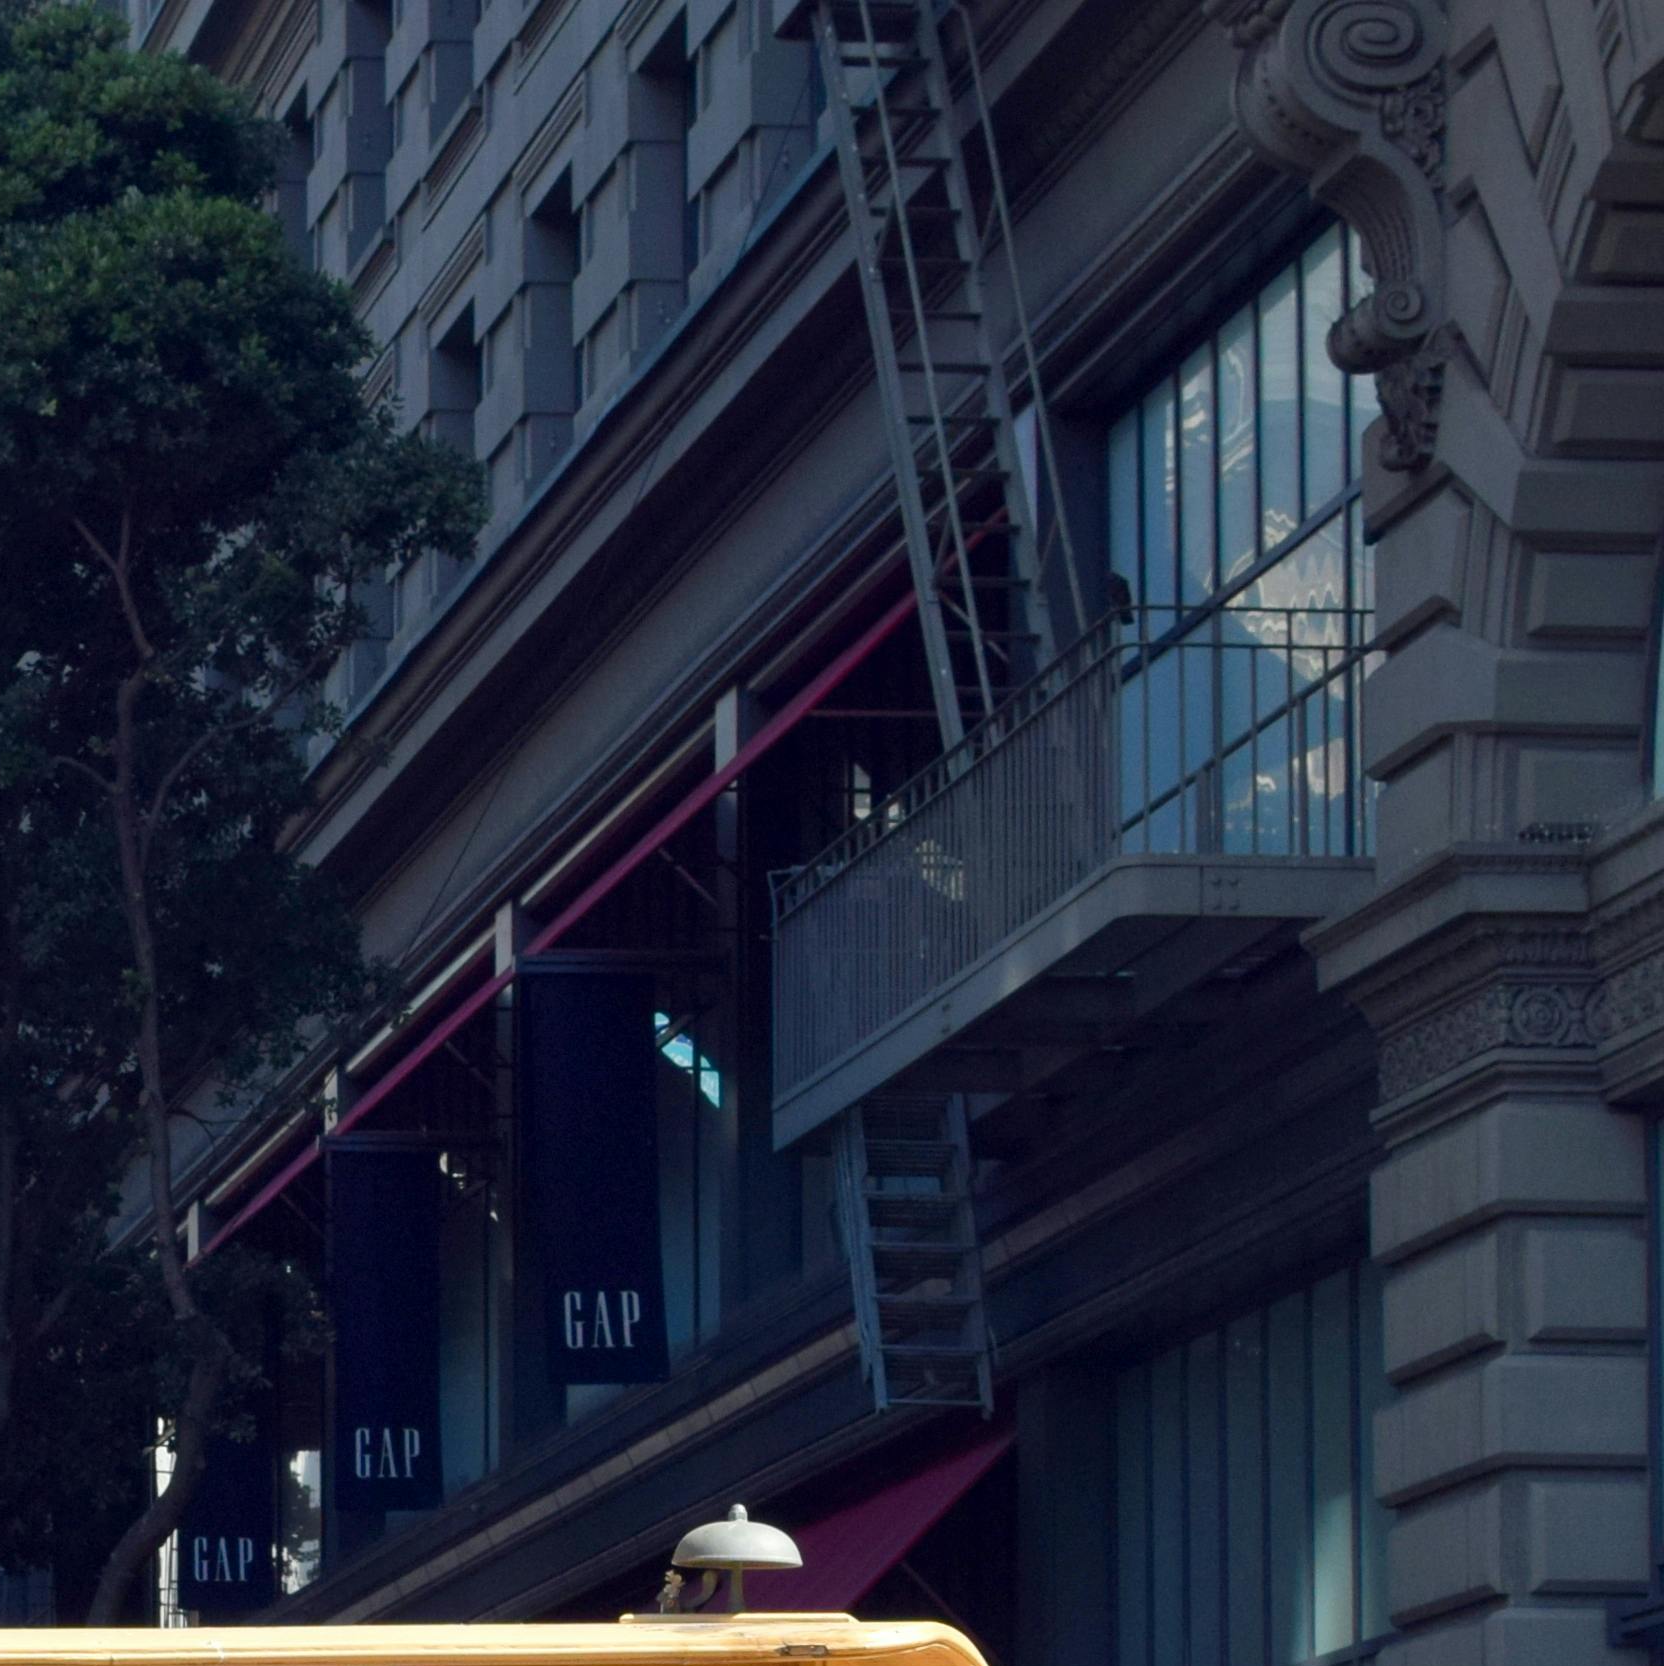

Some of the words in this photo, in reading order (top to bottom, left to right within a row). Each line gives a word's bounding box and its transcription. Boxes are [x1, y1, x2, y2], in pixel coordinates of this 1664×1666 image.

[564, 1290, 642, 1350] GAP
[355, 1427, 420, 1480] GAP
[194, 1535, 253, 1584] GAP
